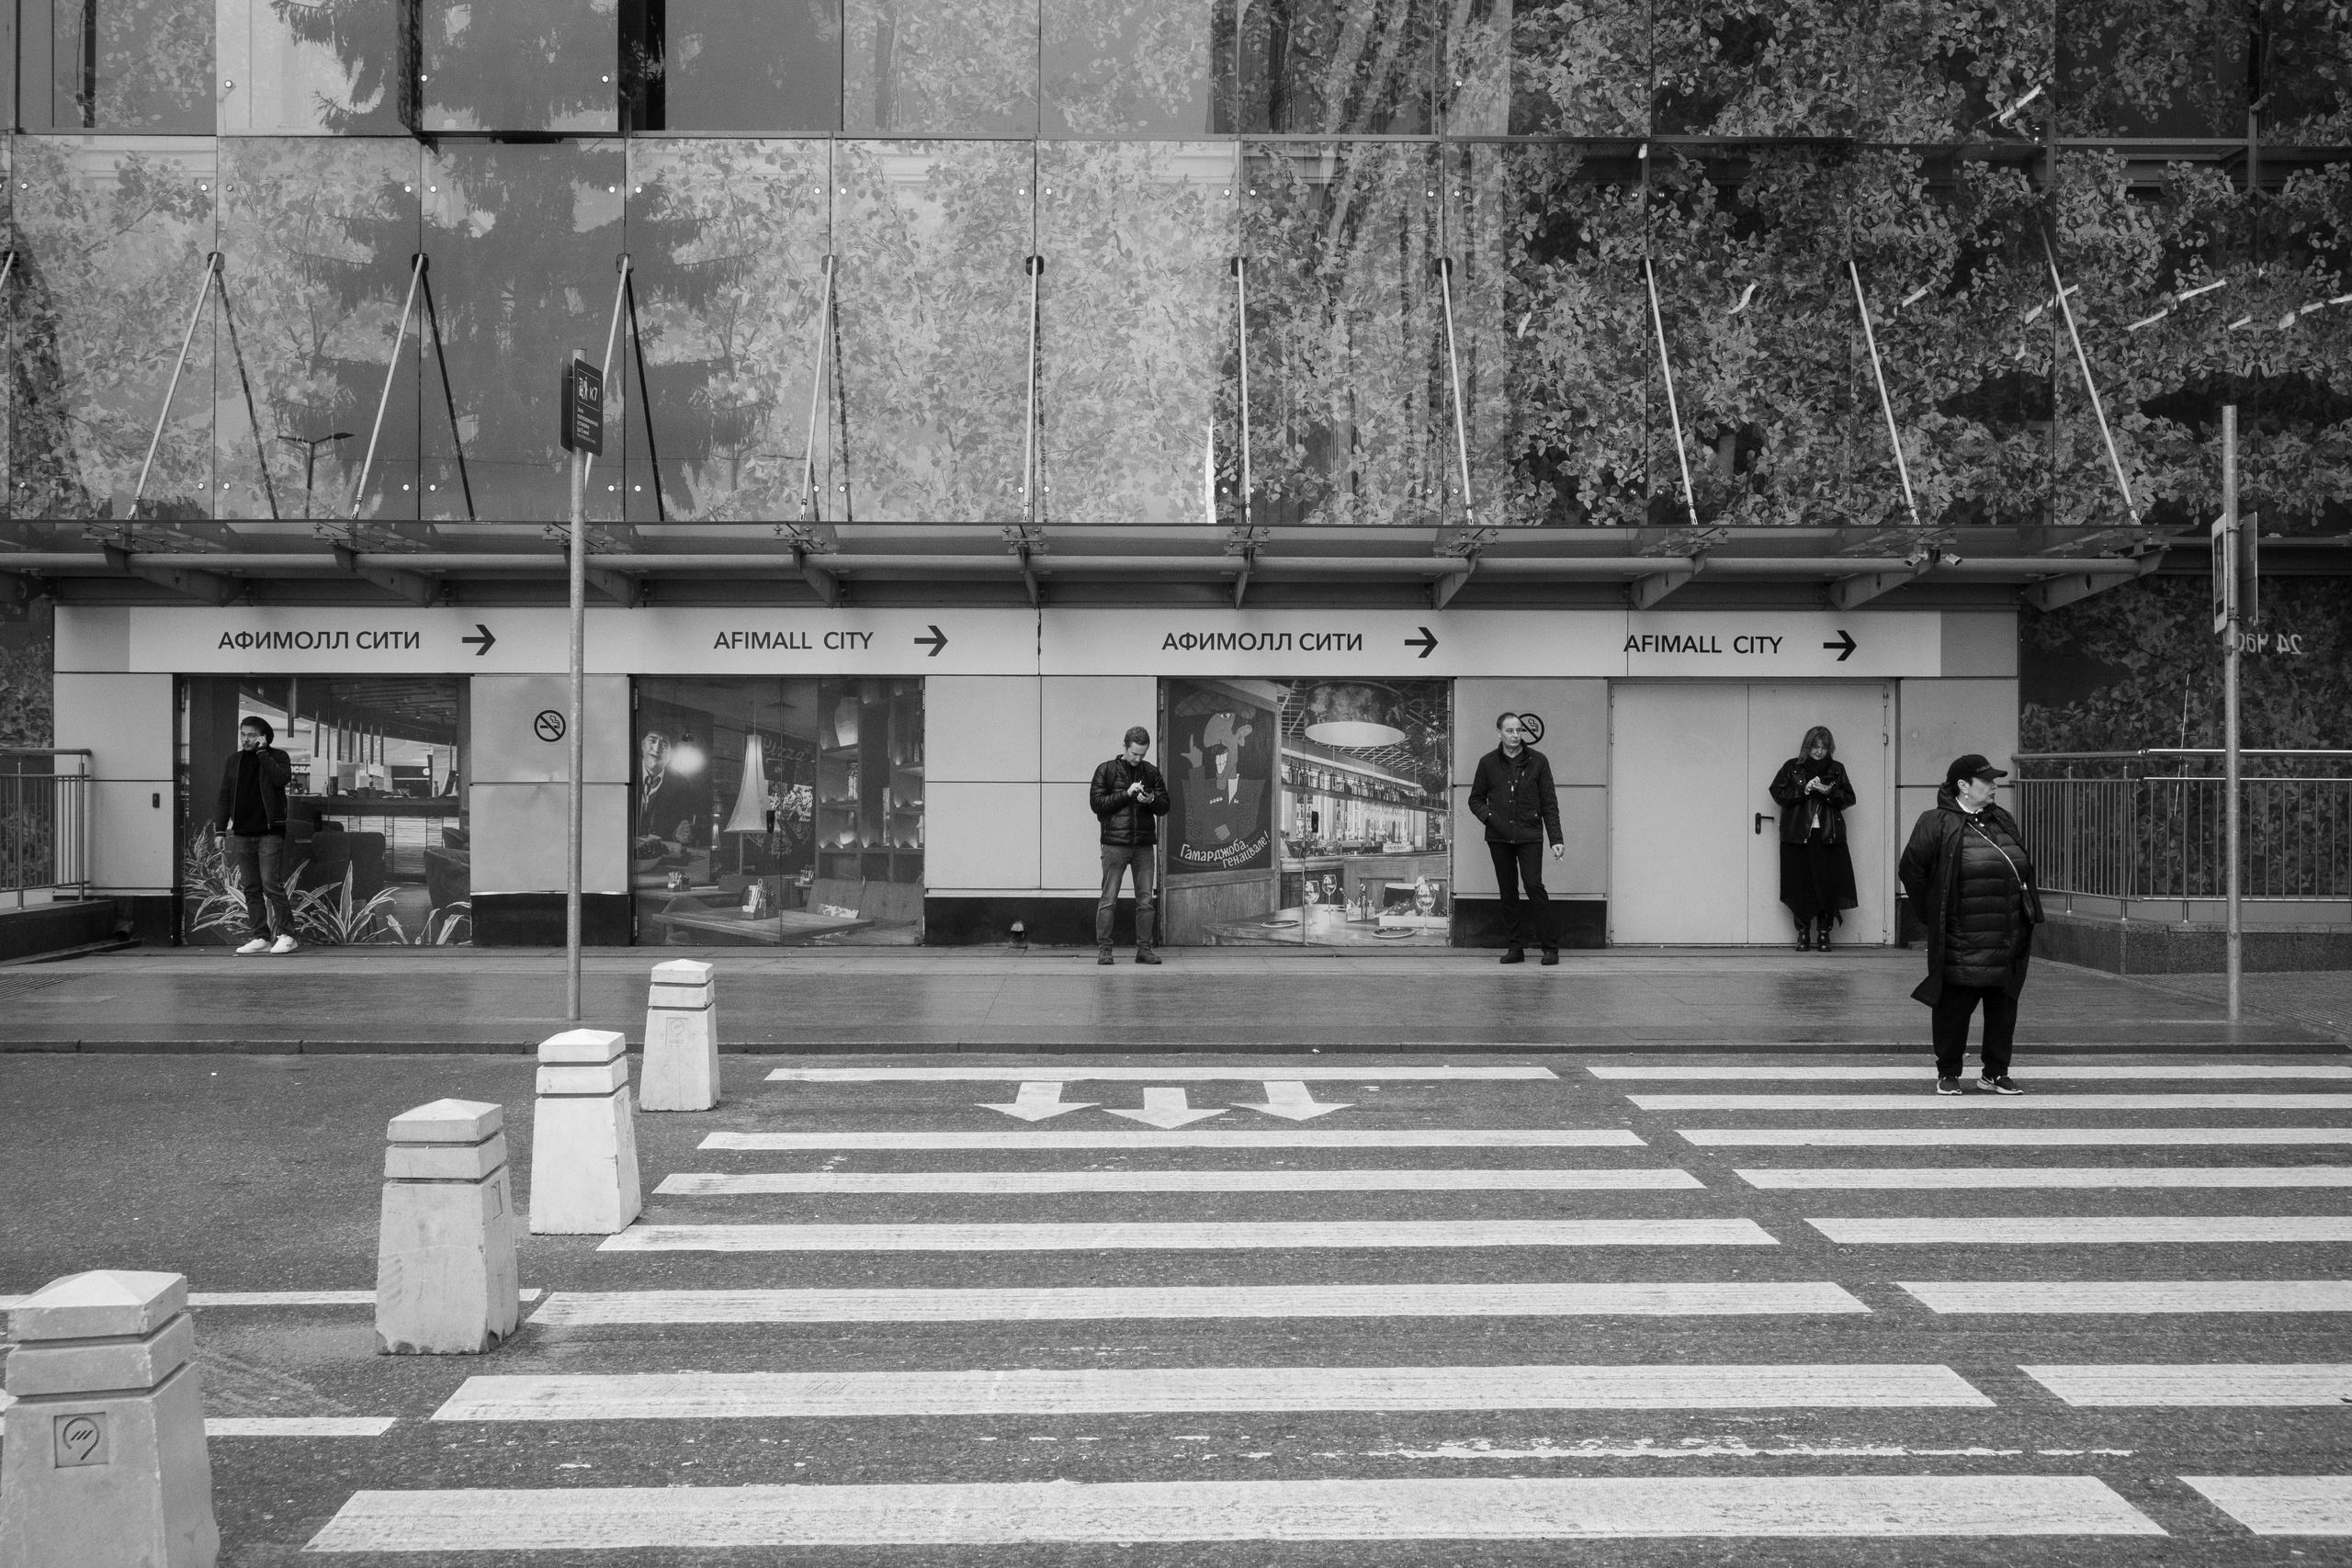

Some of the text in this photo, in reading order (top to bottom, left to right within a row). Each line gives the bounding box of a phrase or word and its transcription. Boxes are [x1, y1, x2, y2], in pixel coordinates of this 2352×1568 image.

[218, 630, 420, 650] АФИМОЛЛ СИТИ
[713, 631, 874, 650] AFIMALL CITY
[1161, 632, 1363, 651] АФИМОЛЛ СИТИ
[1623, 634, 1783, 654] AFIMALL CITY
[1180, 838, 1250, 863] Гамарджоба,
[1222, 829, 1272, 869] генацвале!
